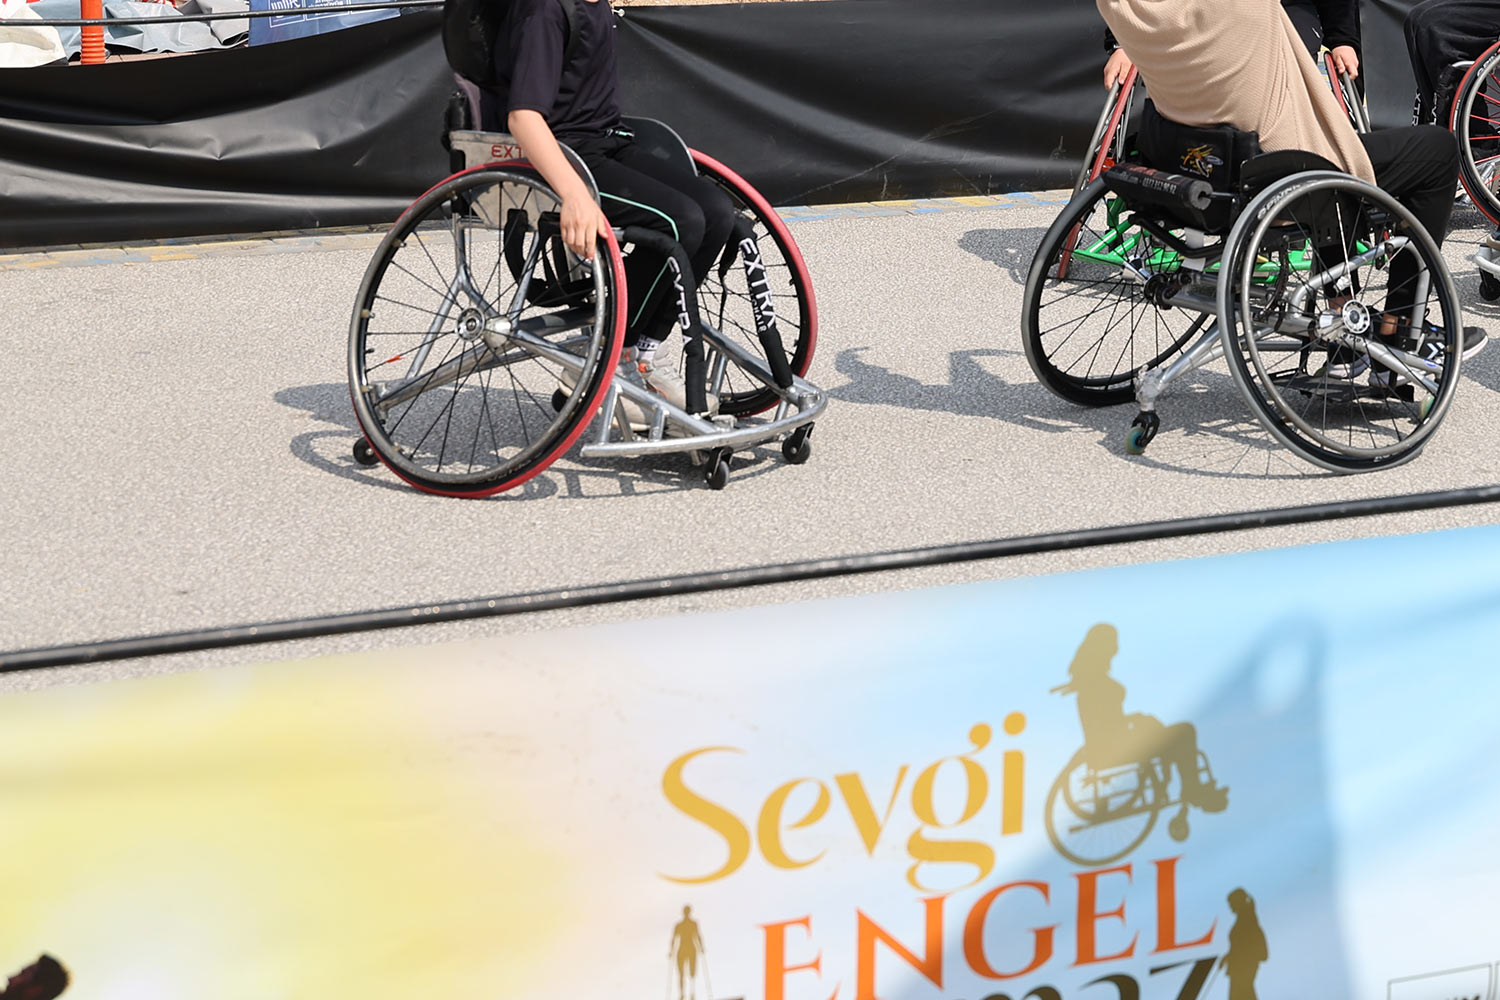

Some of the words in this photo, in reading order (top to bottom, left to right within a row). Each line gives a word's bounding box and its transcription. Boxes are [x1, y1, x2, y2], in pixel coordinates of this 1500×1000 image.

[740, 237, 776, 329] EXTRA
[654, 710, 1027, 895] Sevgi
[754, 854, 1220, 1000] ENGEL
